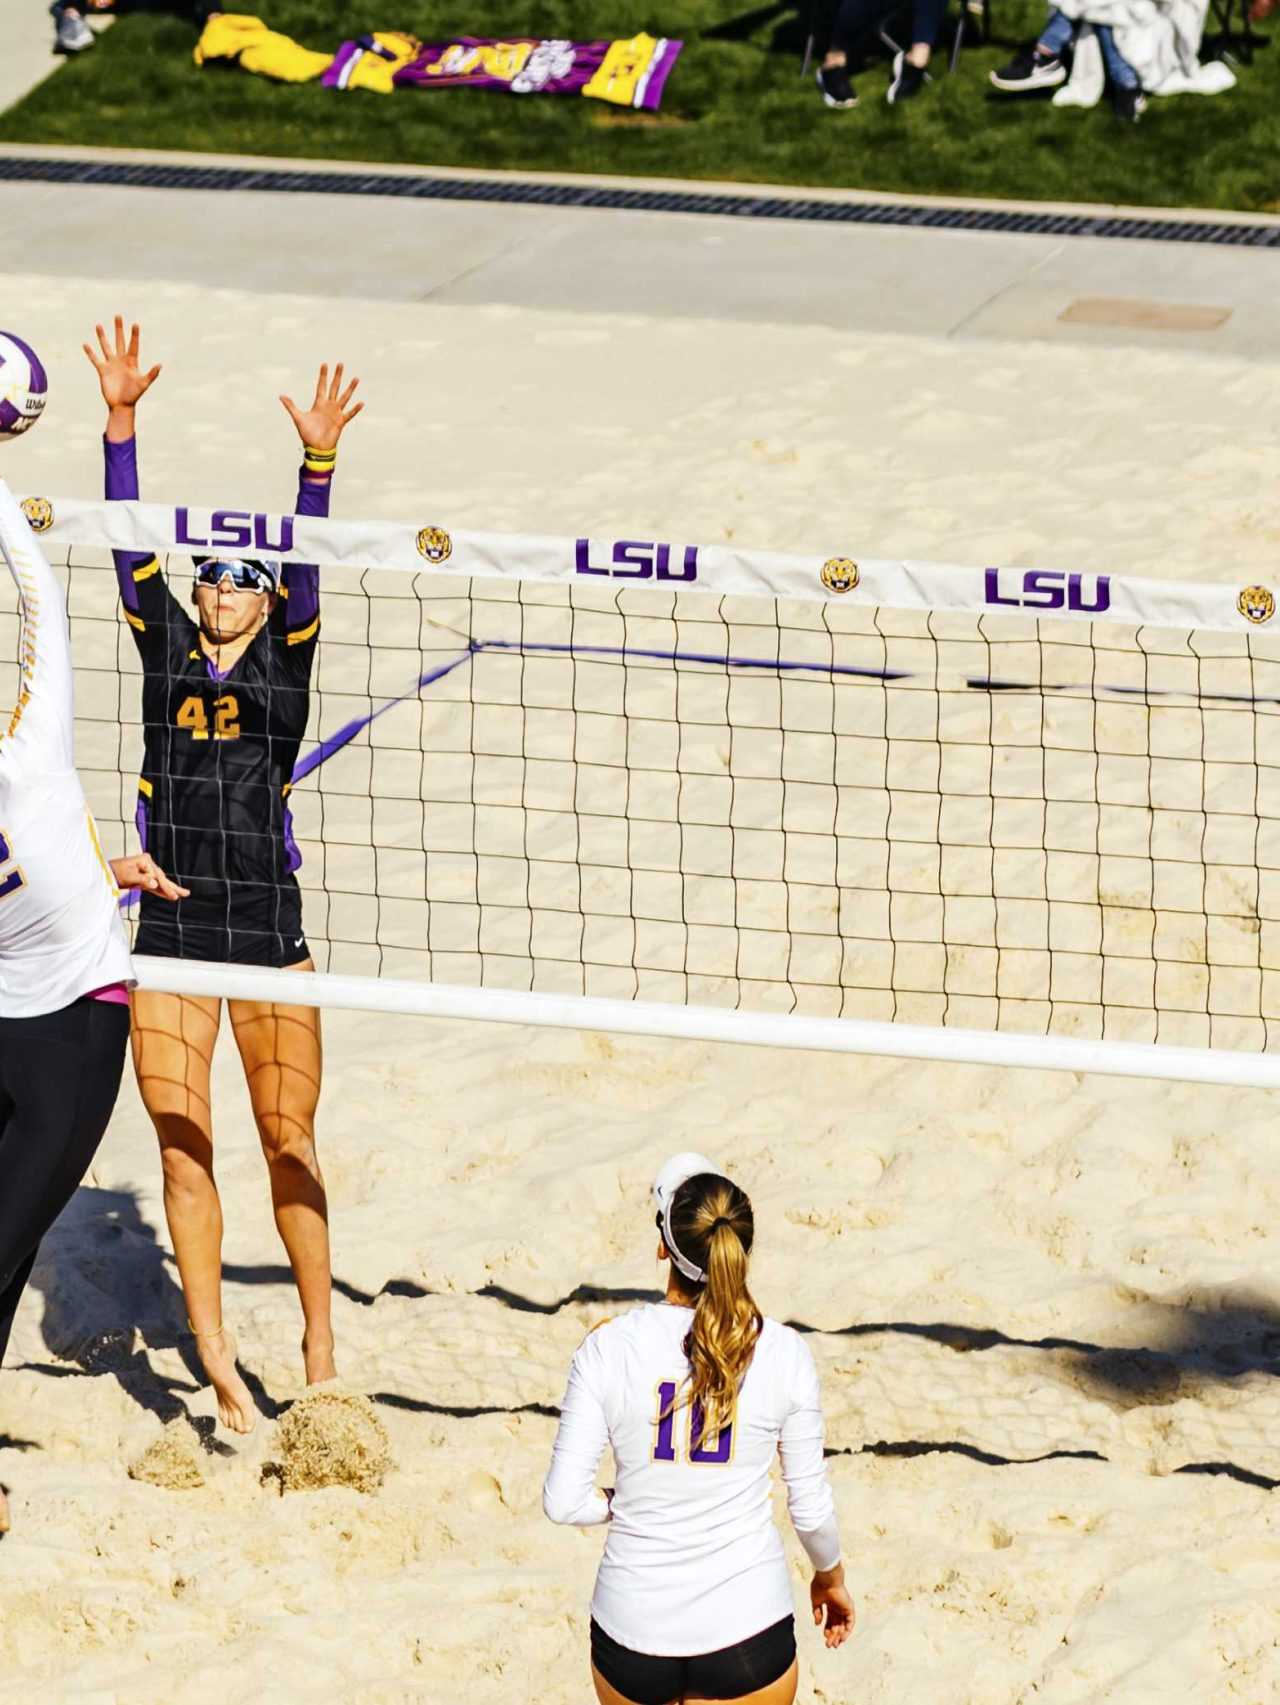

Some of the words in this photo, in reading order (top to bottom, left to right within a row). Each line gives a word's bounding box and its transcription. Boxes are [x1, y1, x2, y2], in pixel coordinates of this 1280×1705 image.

[175, 506, 294, 553] LSU
[575, 538, 698, 583] LSU
[984, 567, 1111, 613] LSU
[176, 695, 240, 740] 42
[652, 1378, 737, 1465] 10
